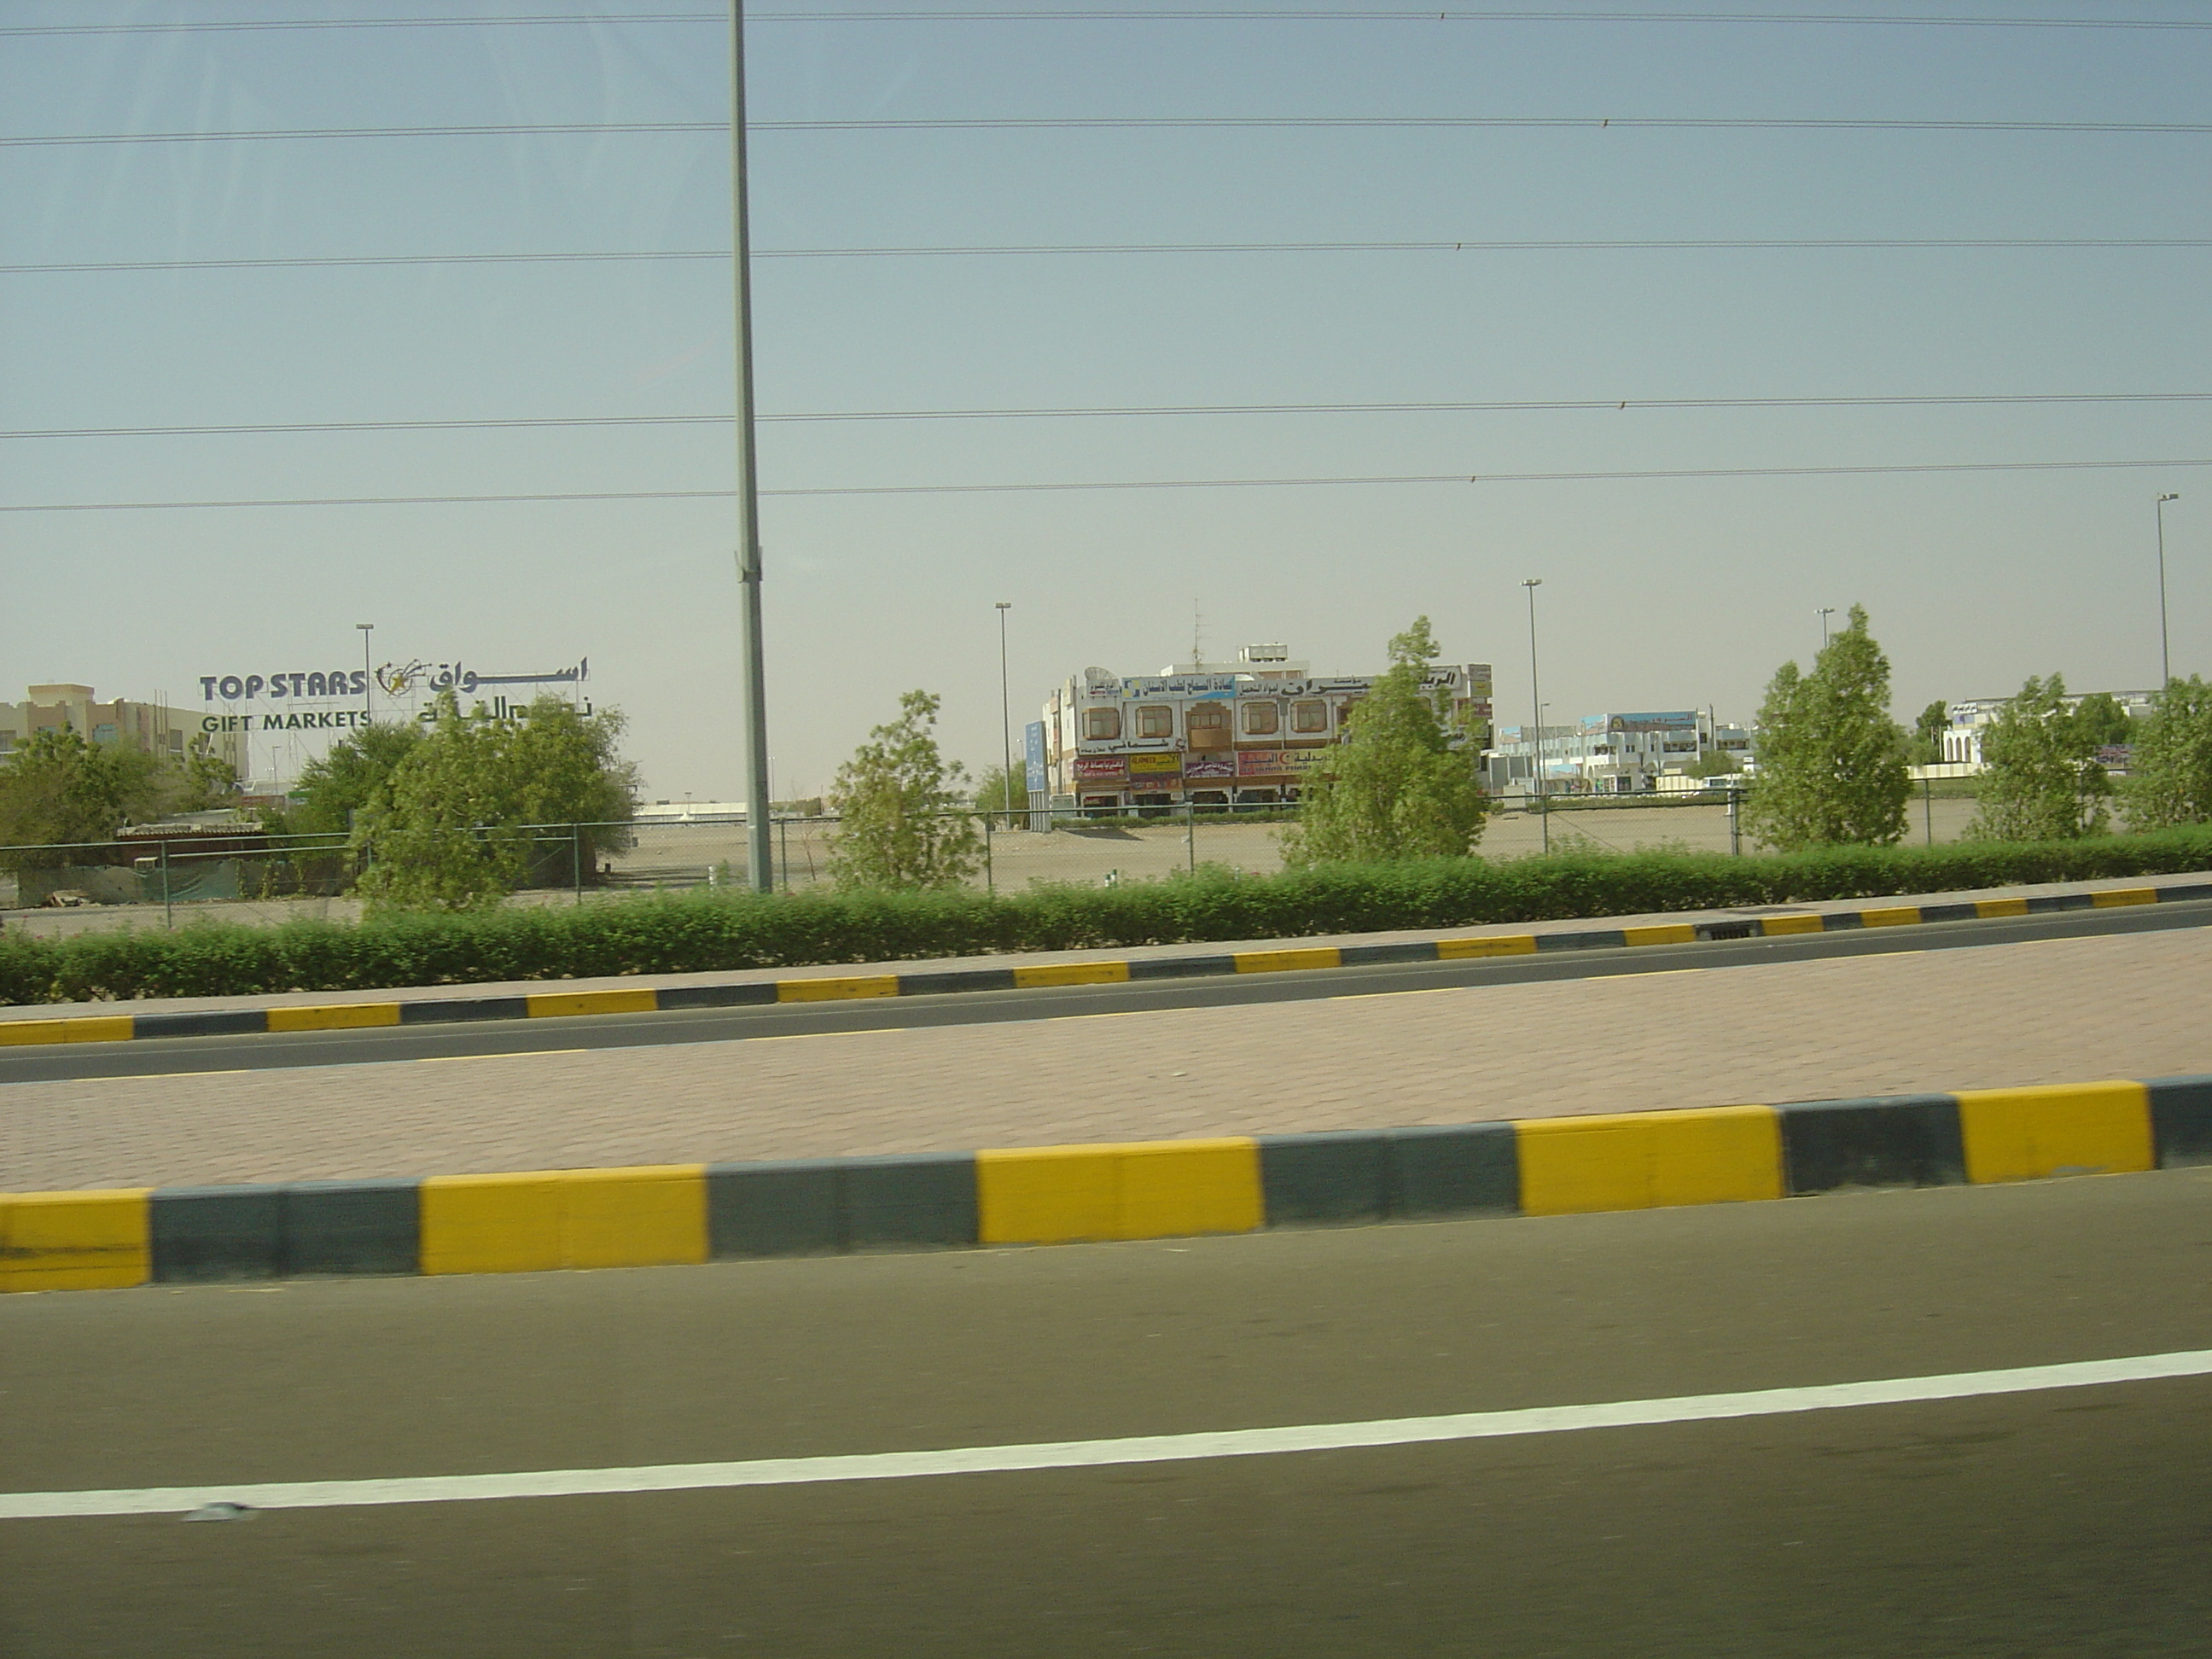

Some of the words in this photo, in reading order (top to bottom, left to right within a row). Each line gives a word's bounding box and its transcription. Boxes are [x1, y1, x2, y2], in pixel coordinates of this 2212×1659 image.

[200, 675, 263, 701] TOP
[271, 670, 366, 698] STARS
[201, 714, 253, 733] GIFT
[263, 709, 372, 731] MARKETS
